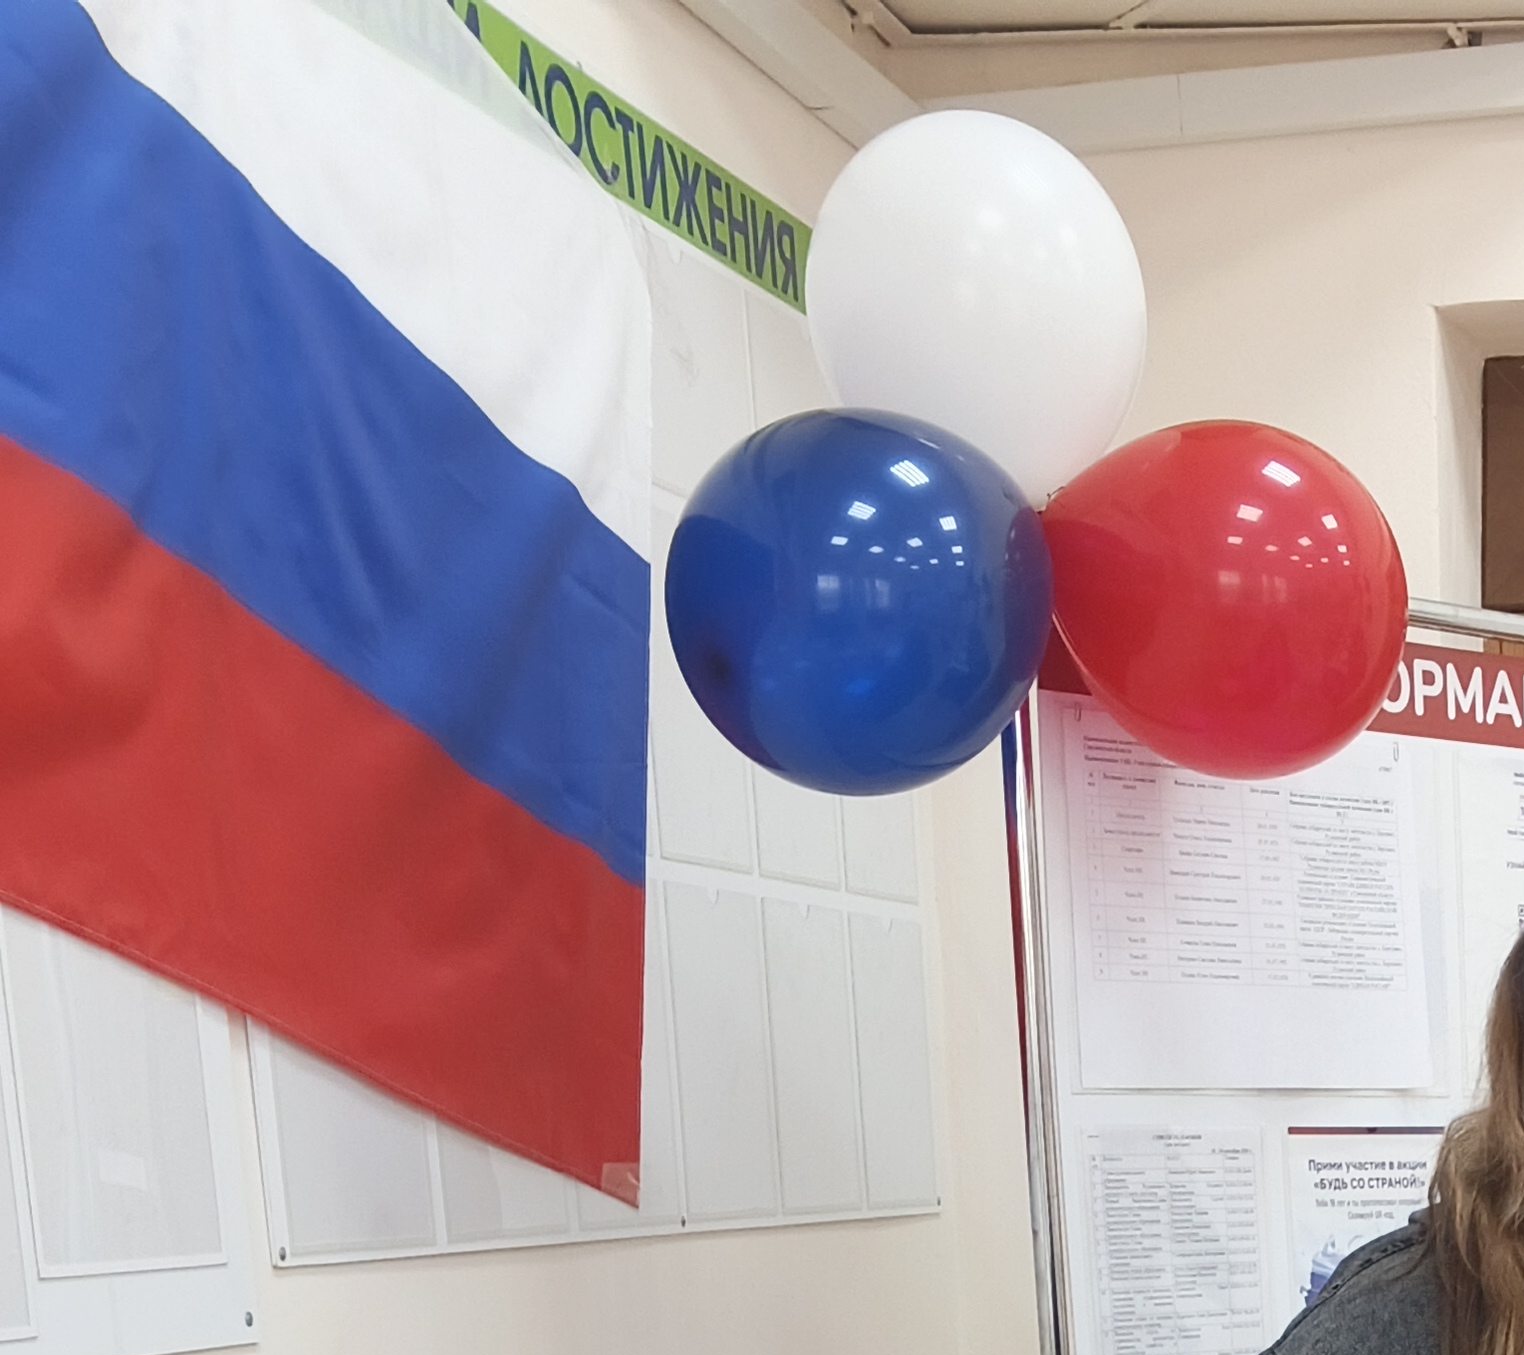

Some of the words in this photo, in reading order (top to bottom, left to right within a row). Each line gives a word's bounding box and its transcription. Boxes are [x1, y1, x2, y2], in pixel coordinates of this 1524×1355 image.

[1308, 1159, 1343, 1173] Прими
[1345, 1160, 1387, 1174] участие
[1389, 1161, 1395, 1170] в
[1397, 1161, 1428, 1172] акции
[1314, 1178, 1348, 1191] «БУДЬ
[1350, 1178, 1366, 1189] СО
